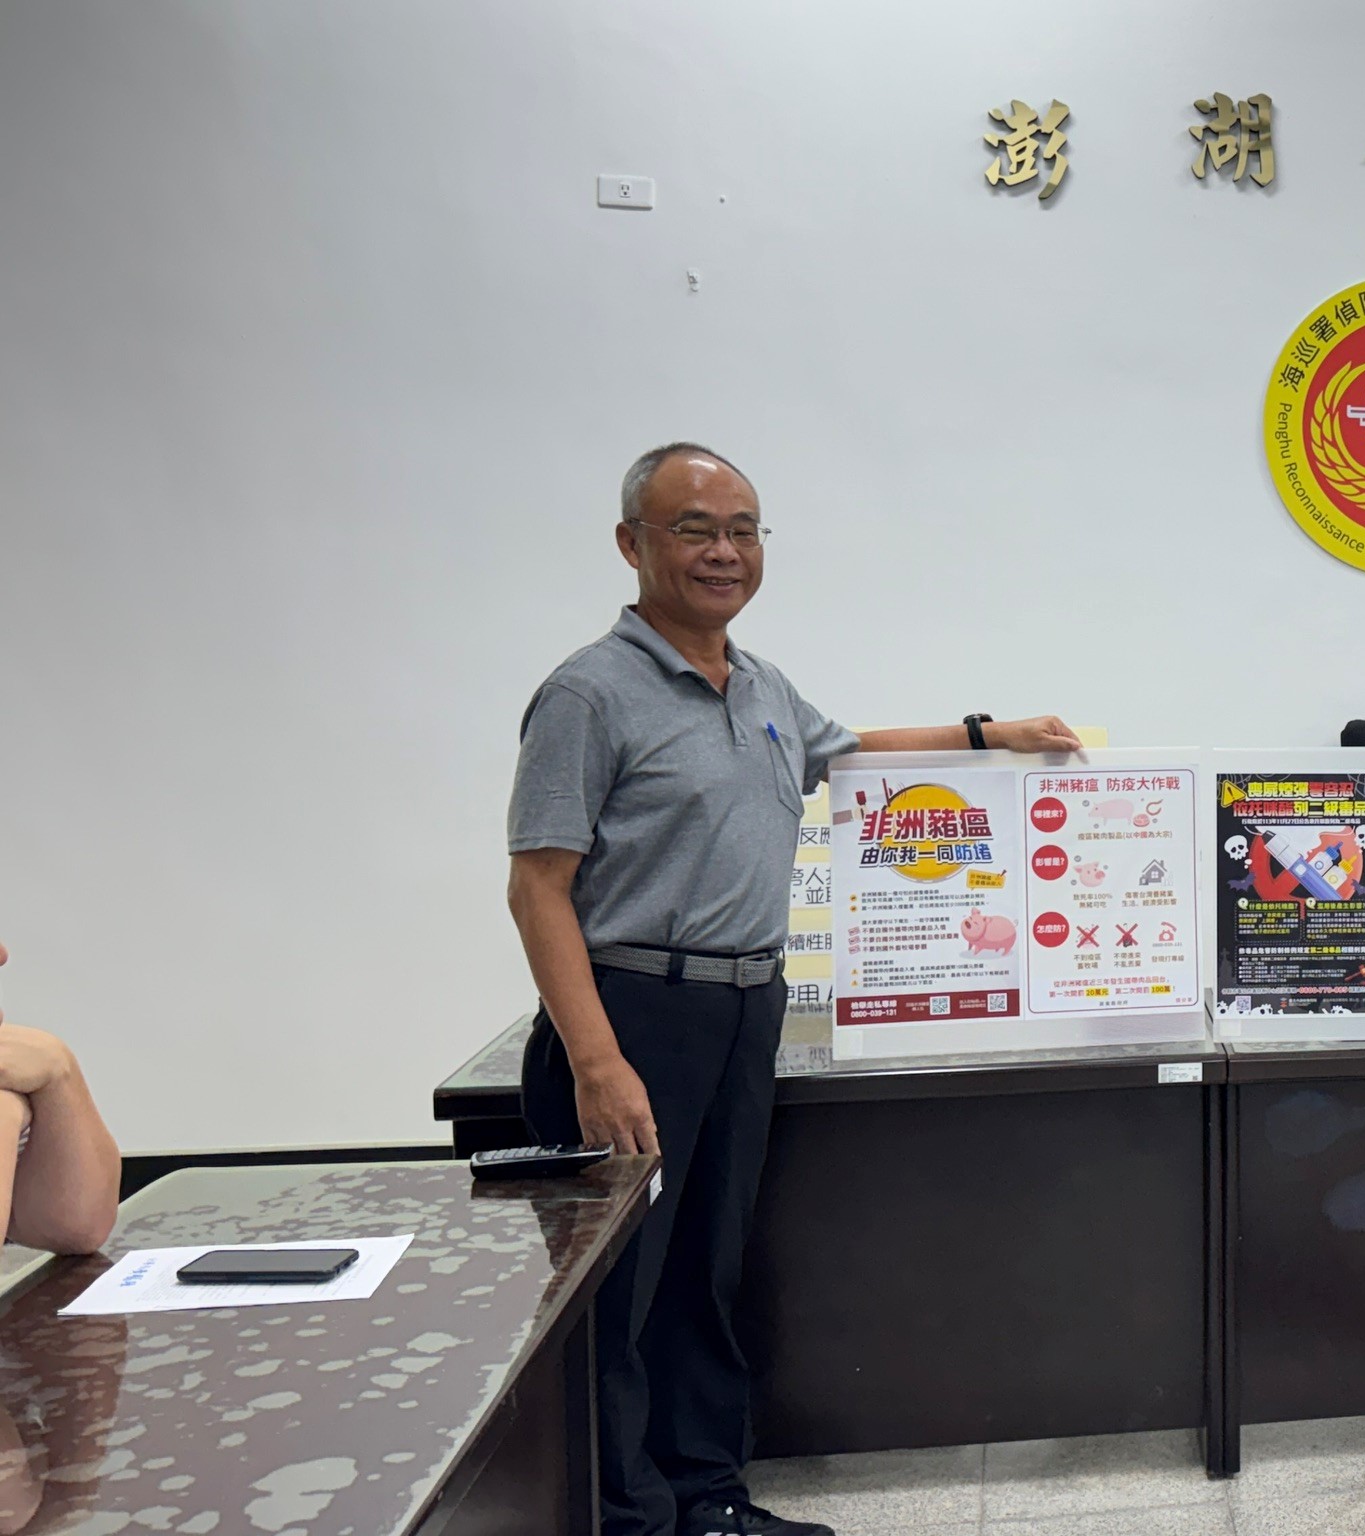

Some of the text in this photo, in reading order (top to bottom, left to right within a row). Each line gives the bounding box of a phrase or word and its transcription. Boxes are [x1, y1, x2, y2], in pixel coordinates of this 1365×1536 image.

[1275, 402, 1293, 459] Penghu
[1284, 462, 1365, 553] Reconnaissance
[1039, 776, 1180, 793] 非洲豬瘟 防疫大作戰
[859, 808, 993, 843] 非洲豬瘟
[860, 843, 993, 866] 由你我一同防堵
